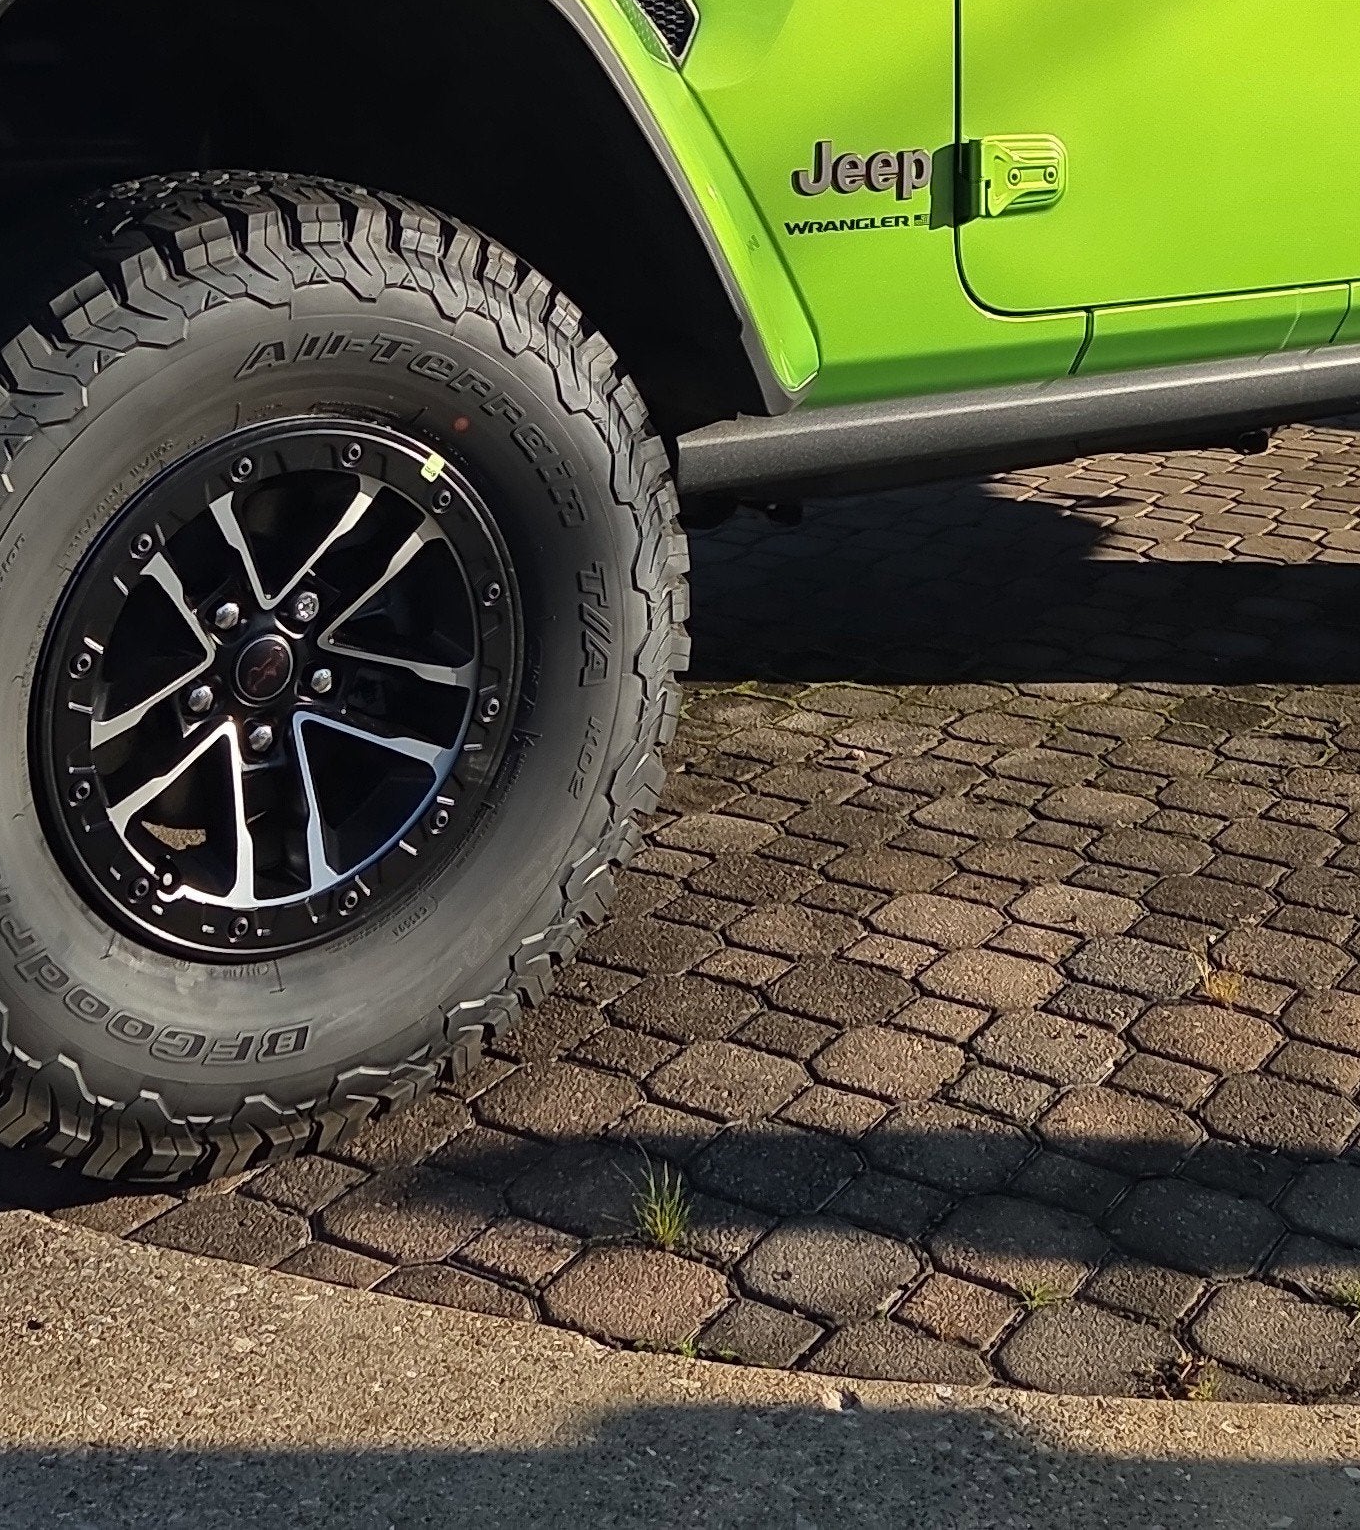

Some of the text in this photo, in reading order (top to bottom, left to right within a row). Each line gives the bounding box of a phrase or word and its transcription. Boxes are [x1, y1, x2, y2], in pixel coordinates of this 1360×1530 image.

[791, 139, 931, 201] Jeep
[784, 215, 910, 236] WRANGLER
[235, 331, 591, 529] All-Terrain
[577, 560, 613, 687] T/A
